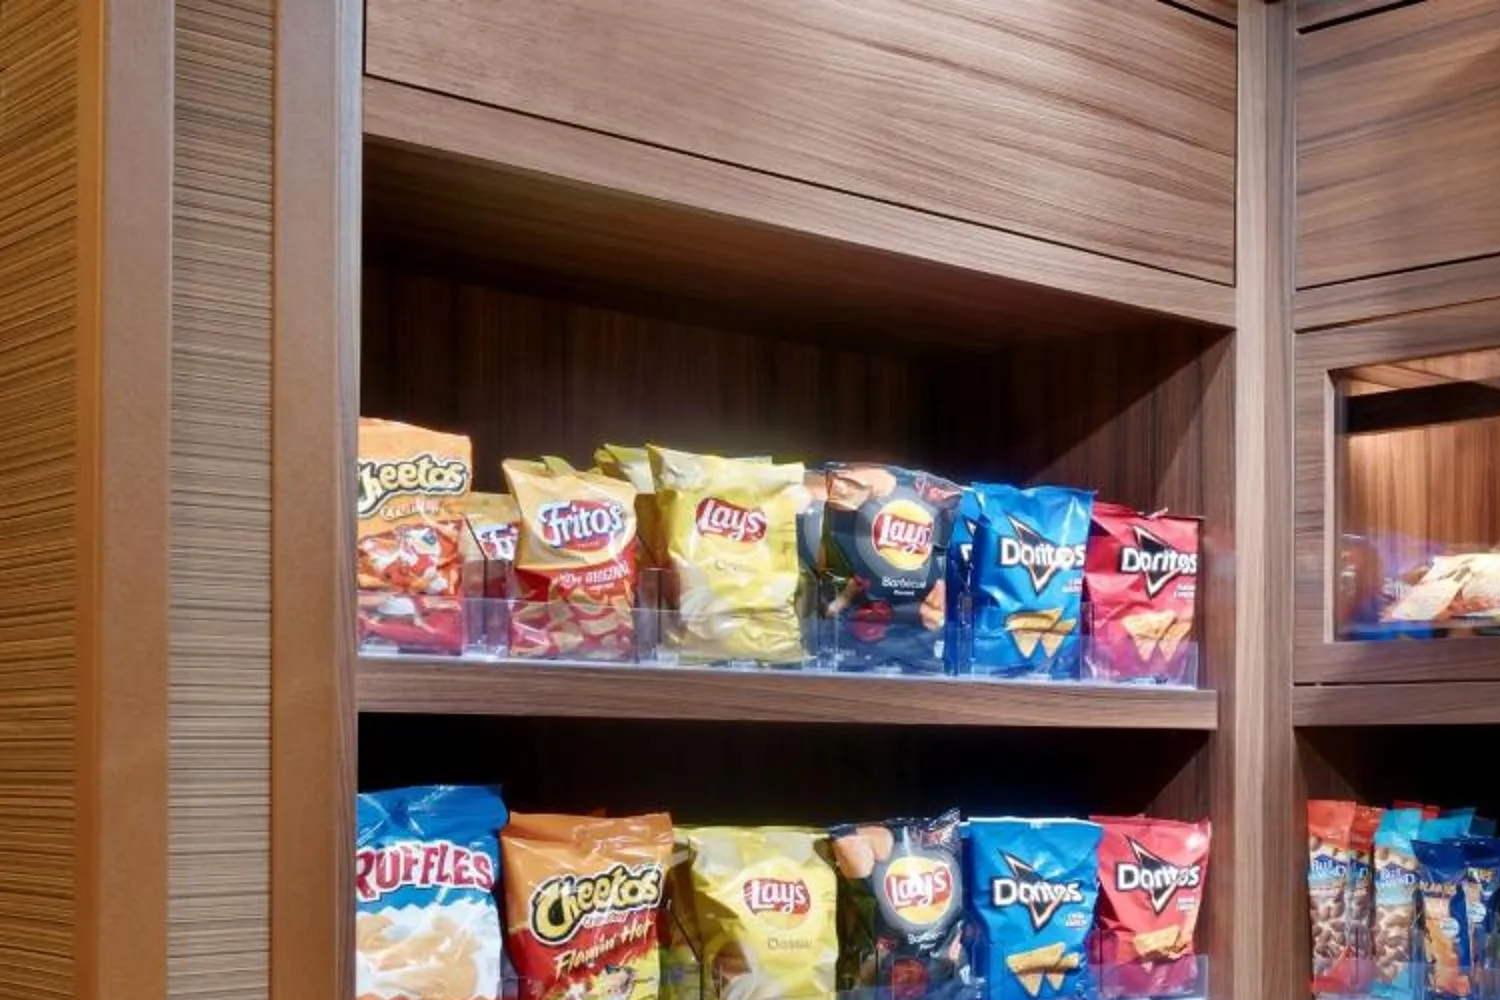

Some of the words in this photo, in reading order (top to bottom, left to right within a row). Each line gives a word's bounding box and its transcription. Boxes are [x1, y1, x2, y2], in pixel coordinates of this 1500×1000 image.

[538, 501, 624, 548] Fritos
[1001, 537, 1086, 571] Doritos
[1121, 547, 1198, 573] Doritos
[356, 843, 494, 899] RUFFLES
[1117, 863, 1200, 891] Doritos
[531, 866, 662, 943] Cheetos
[993, 877, 1083, 906] Doritos
